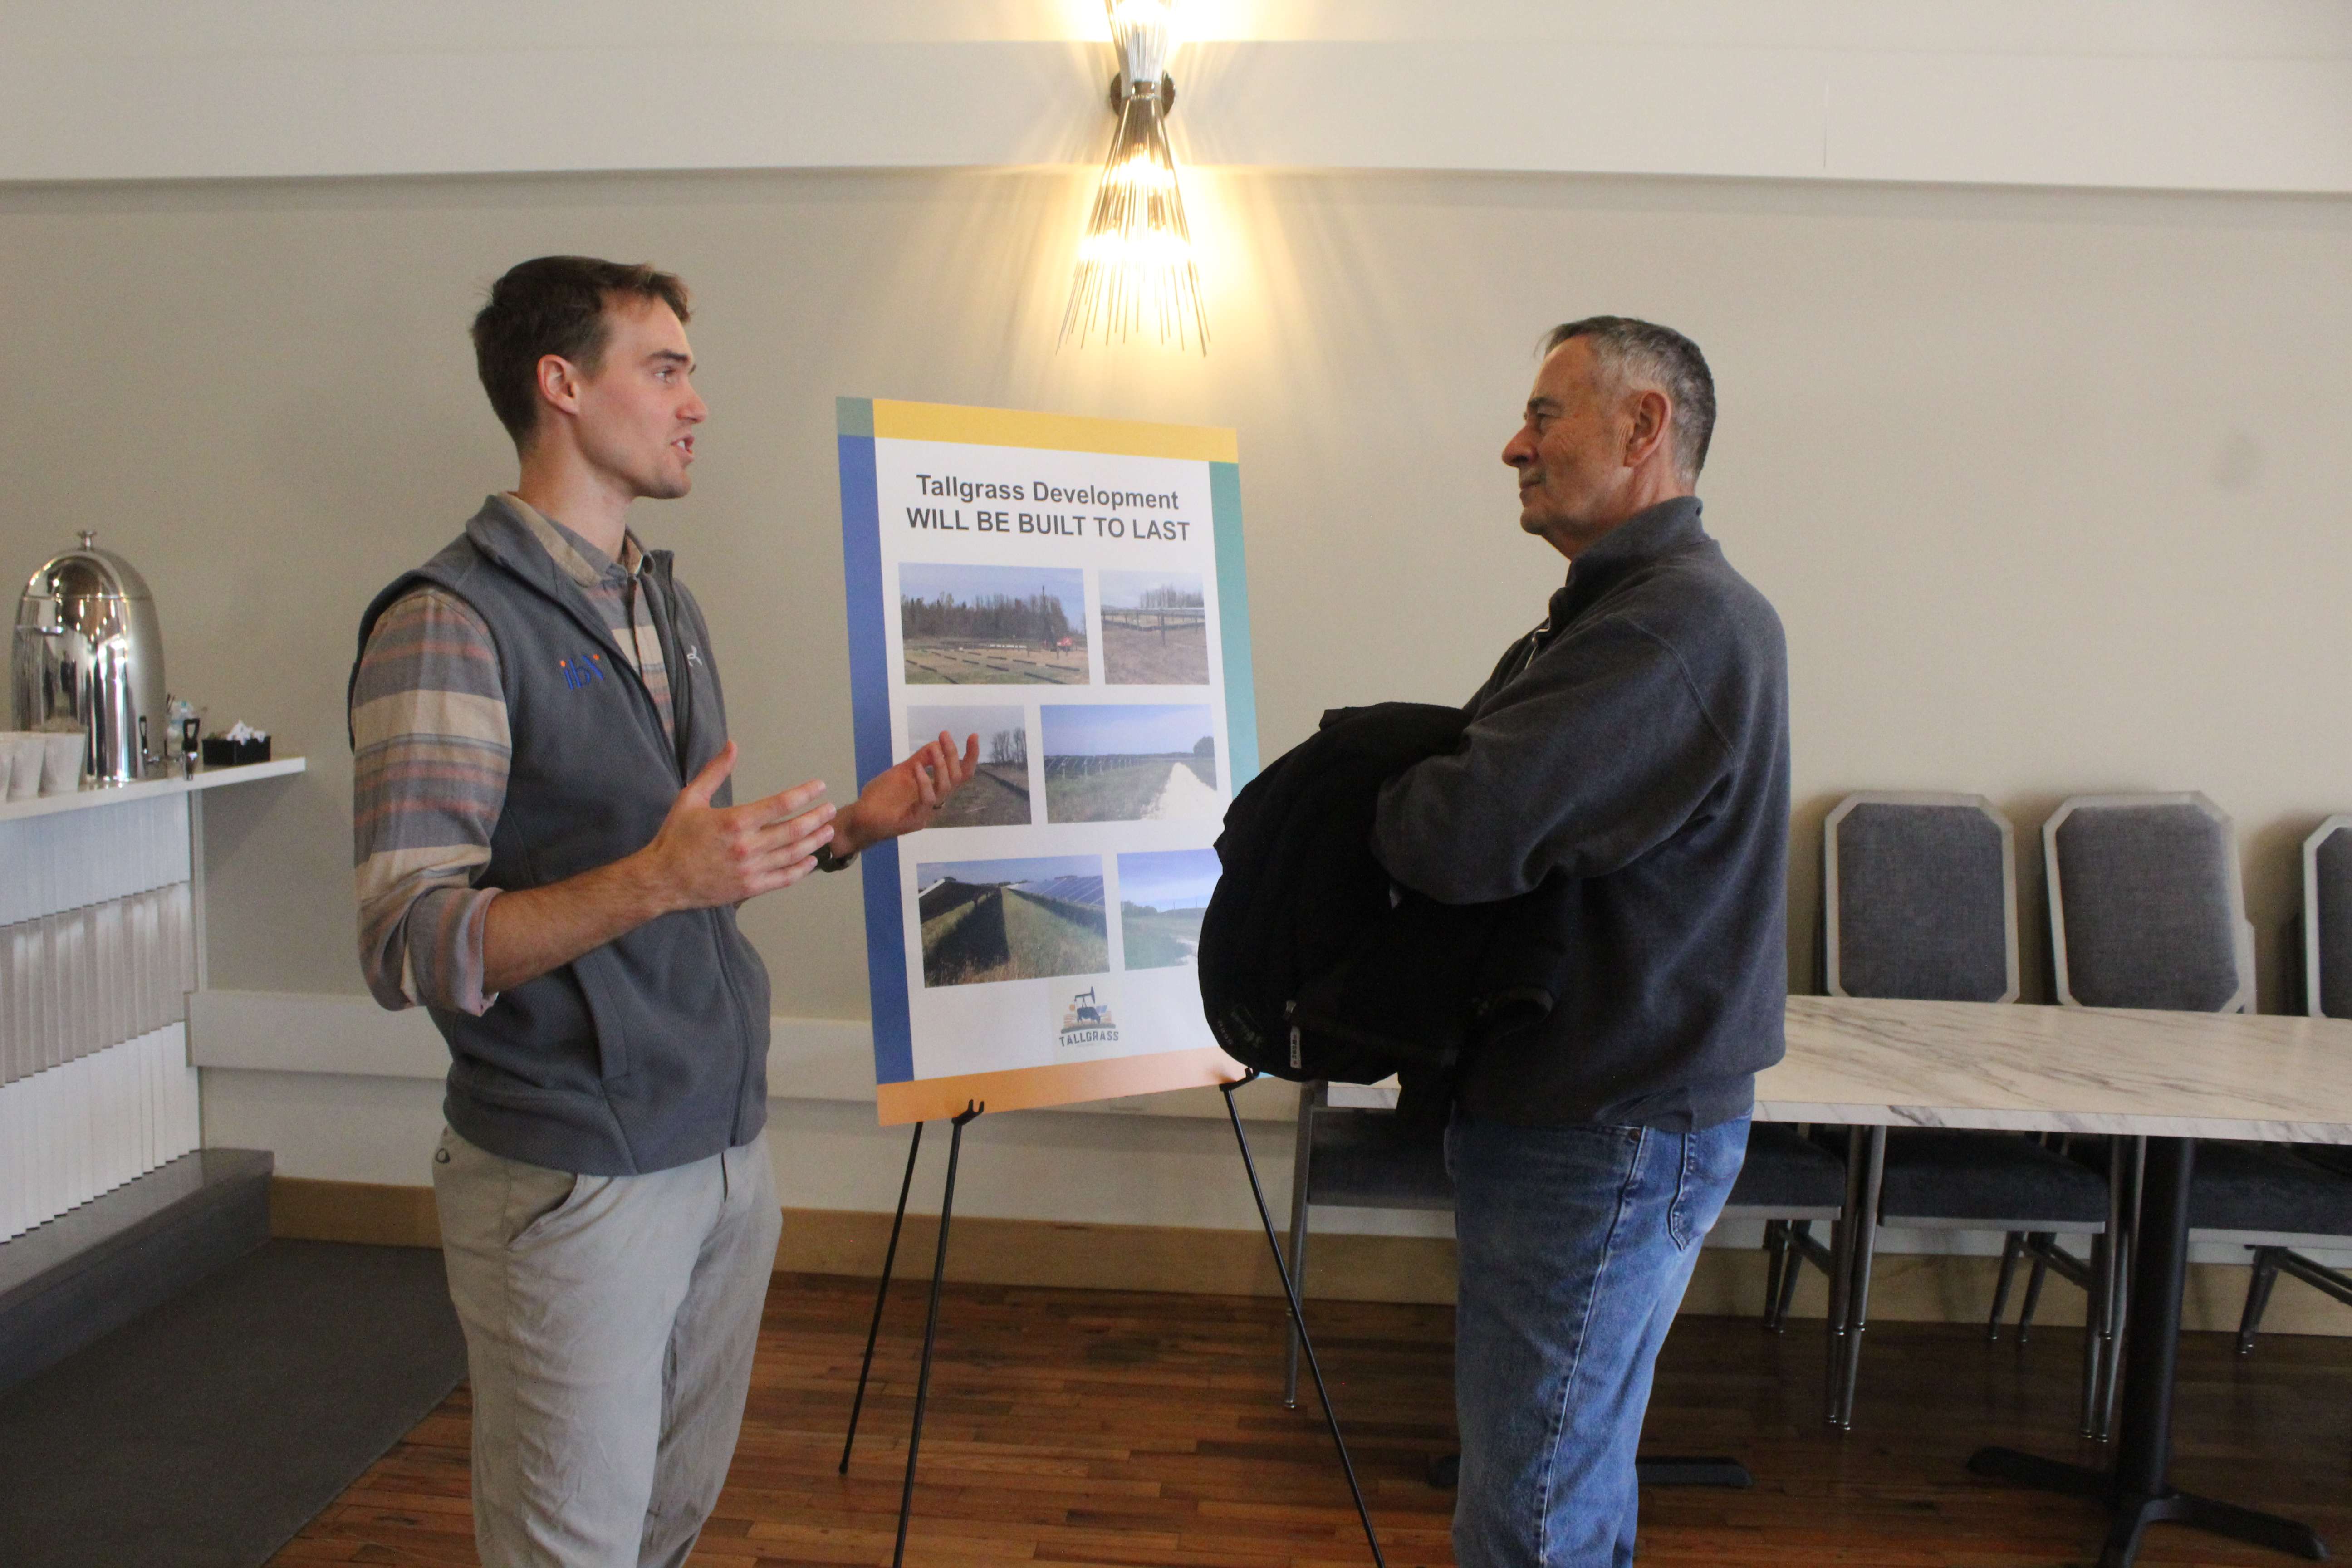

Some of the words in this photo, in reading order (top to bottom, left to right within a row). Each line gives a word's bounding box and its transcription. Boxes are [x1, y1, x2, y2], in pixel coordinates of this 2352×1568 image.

[916, 474, 1024, 503] Tallgrass
[1033, 481, 1179, 510] Development
[906, 507, 969, 530] WILL
[977, 511, 1010, 532] BE
[1019, 513, 1086, 535] BUILT
[1093, 517, 1125, 538] TO
[1133, 519, 1190, 541] LAST
[1059, 1030, 1119, 1047] TALLGRASS
